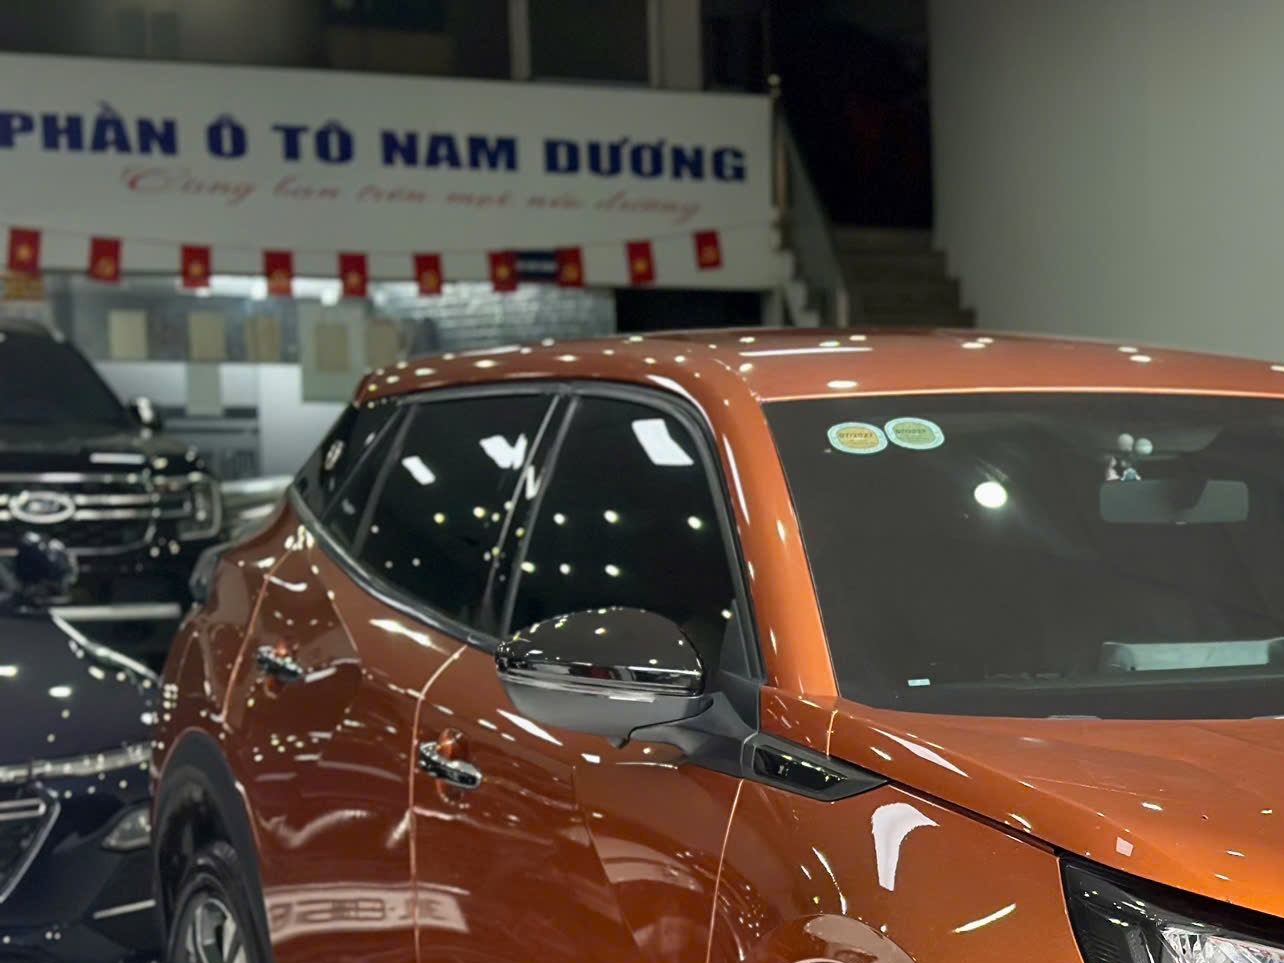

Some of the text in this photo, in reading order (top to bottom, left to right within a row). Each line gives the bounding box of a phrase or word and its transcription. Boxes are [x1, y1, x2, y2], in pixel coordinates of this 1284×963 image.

[0, 101, 746, 182] PHẦN Ô TÔ NAM DƯƠNG
